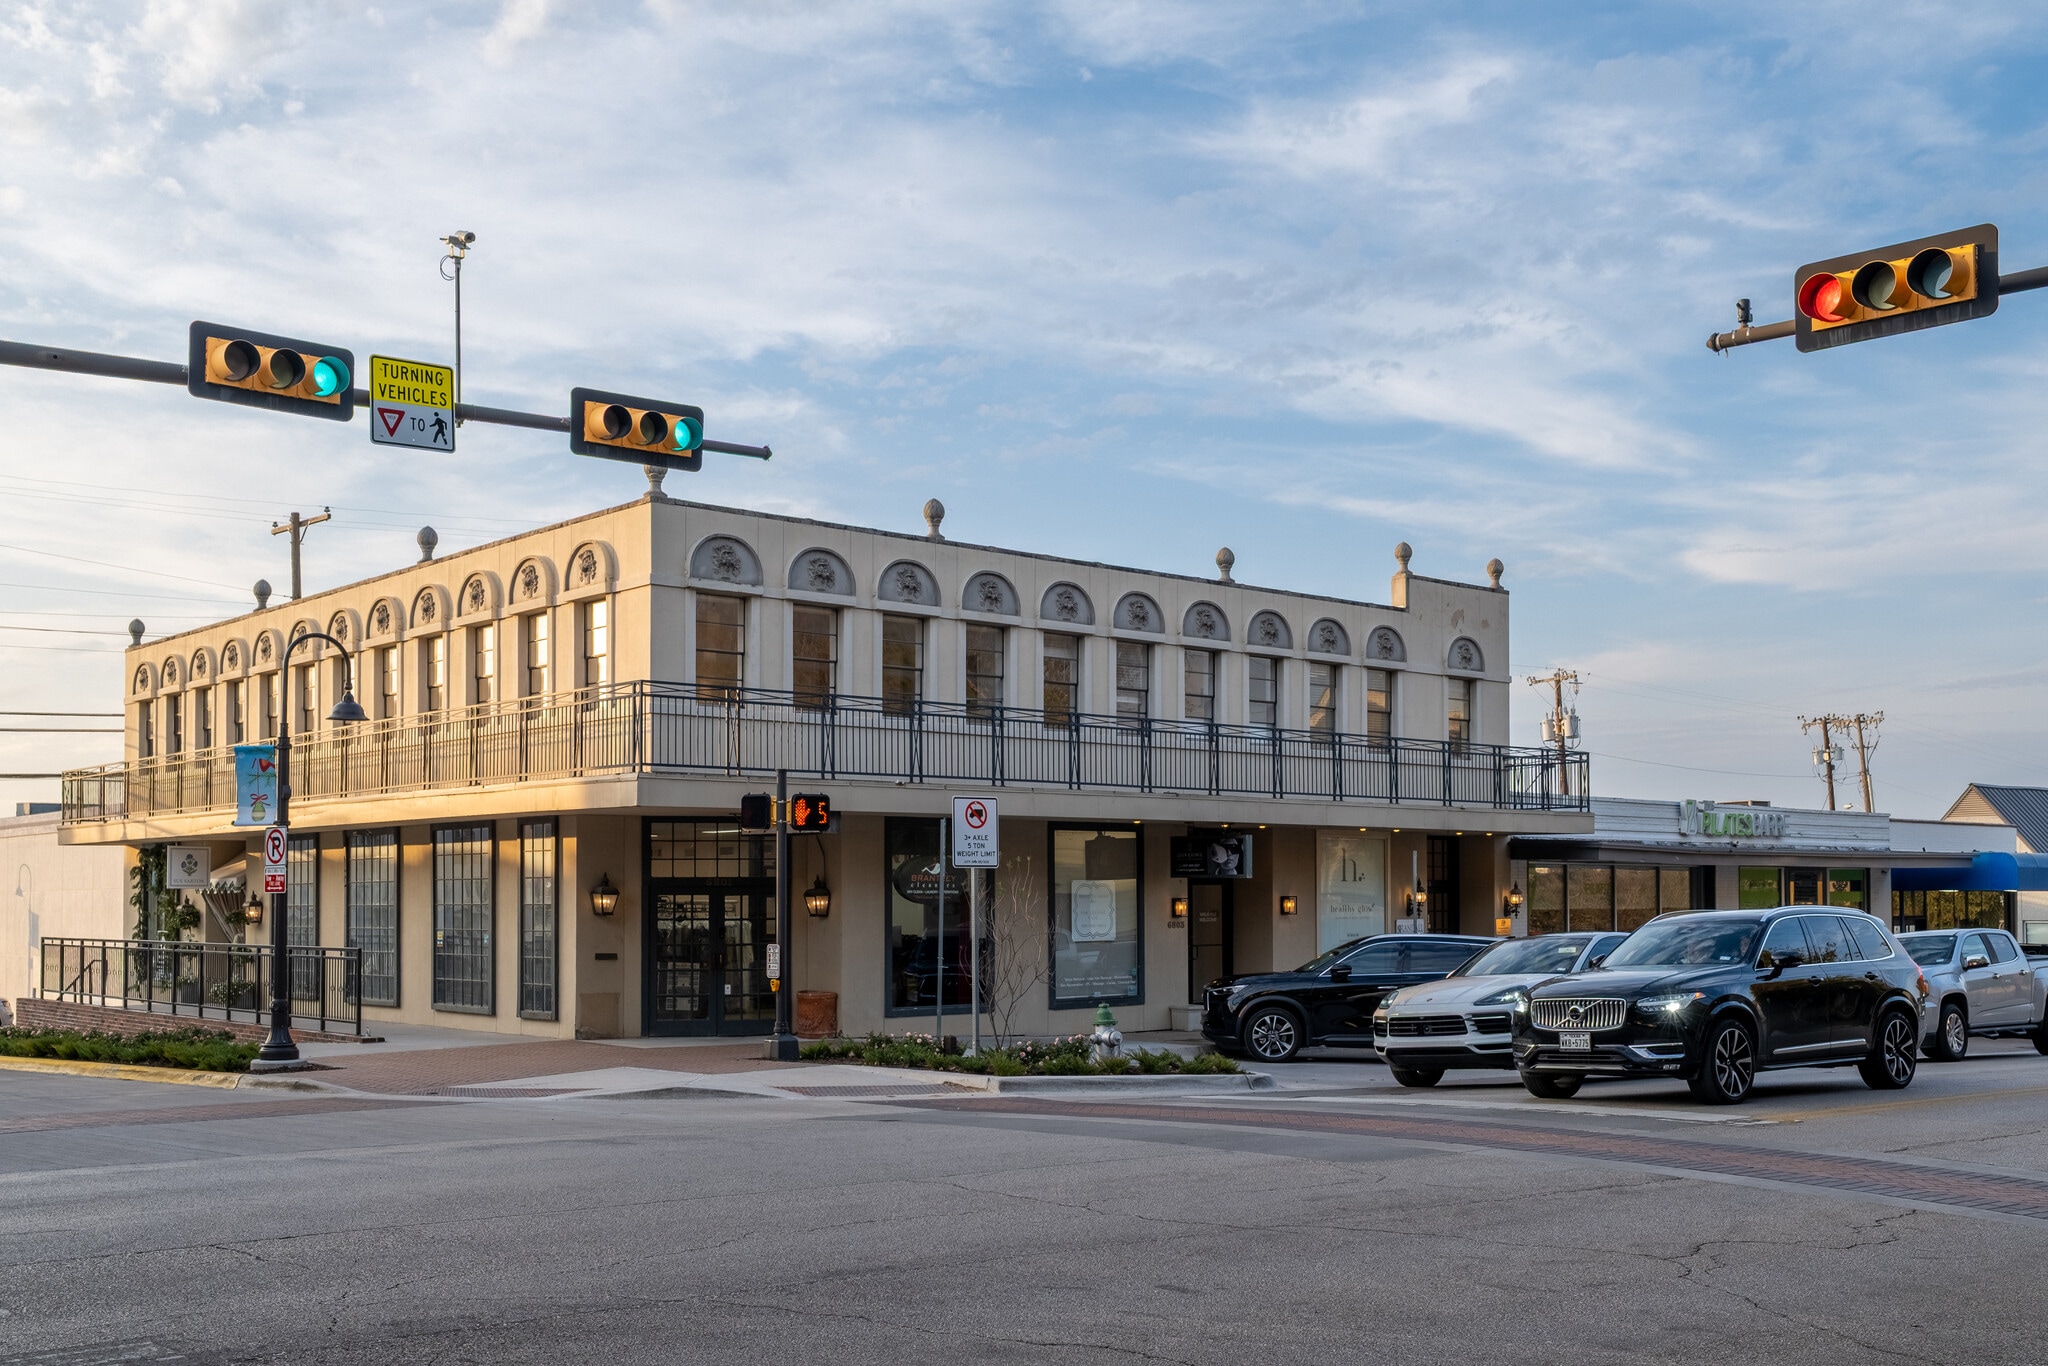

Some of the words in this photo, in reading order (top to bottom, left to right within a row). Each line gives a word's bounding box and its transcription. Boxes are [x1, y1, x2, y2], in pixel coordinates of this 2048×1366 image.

[382, 363, 443, 386] TURNING
[378, 383, 447, 406] VEHICLES
[410, 417, 425, 432] TO
[818, 801, 827, 824] 5
[911, 874, 957, 882] BRANTEY
[1330, 904, 1355, 914] healthy
